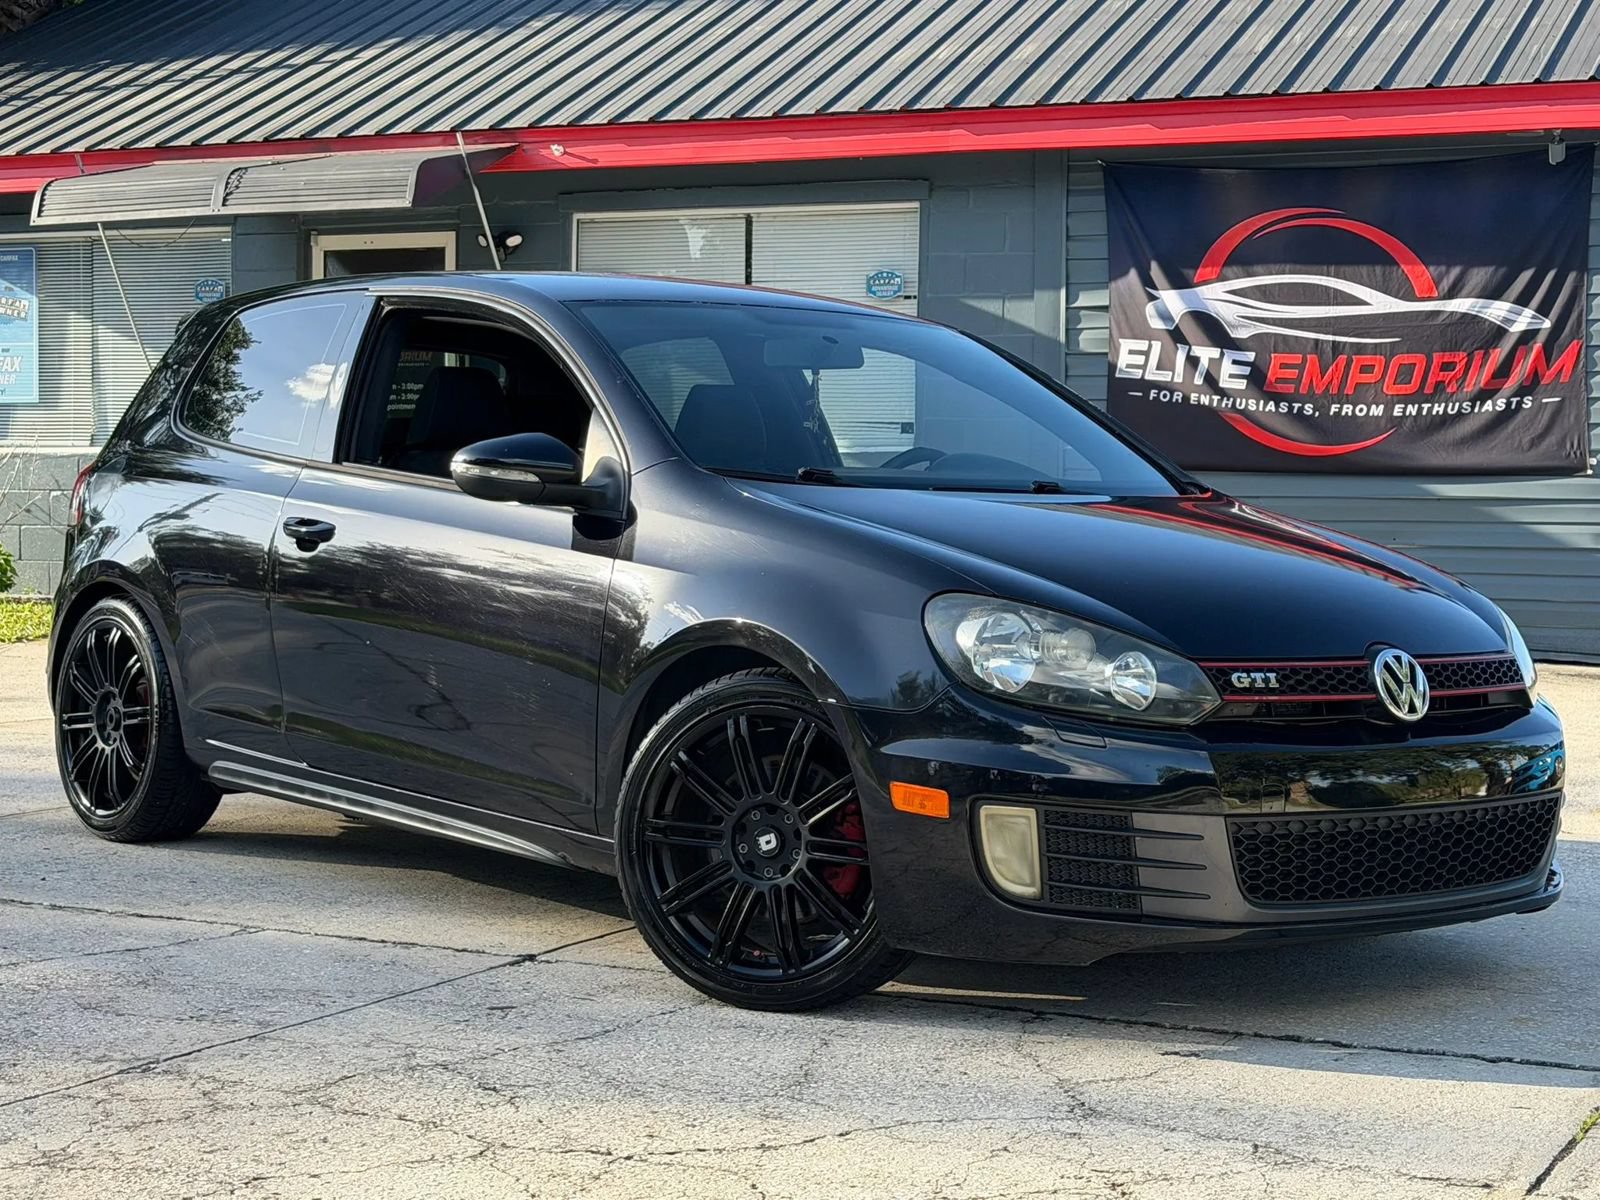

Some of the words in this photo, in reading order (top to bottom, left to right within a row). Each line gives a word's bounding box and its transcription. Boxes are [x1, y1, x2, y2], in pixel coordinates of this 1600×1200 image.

[870, 277, 901, 285] CARFAX
[1115, 339, 1256, 390] ELITE
[1263, 338, 1584, 396] EMPORIUM
[1149, 389, 1183, 403] FOR
[1190, 394, 1321, 418] ENTHUSIASTS,
[1329, 403, 1384, 417] FROM
[1393, 396, 1534, 417] ENTHUSIASTS
[1231, 672, 1279, 688] GTI
